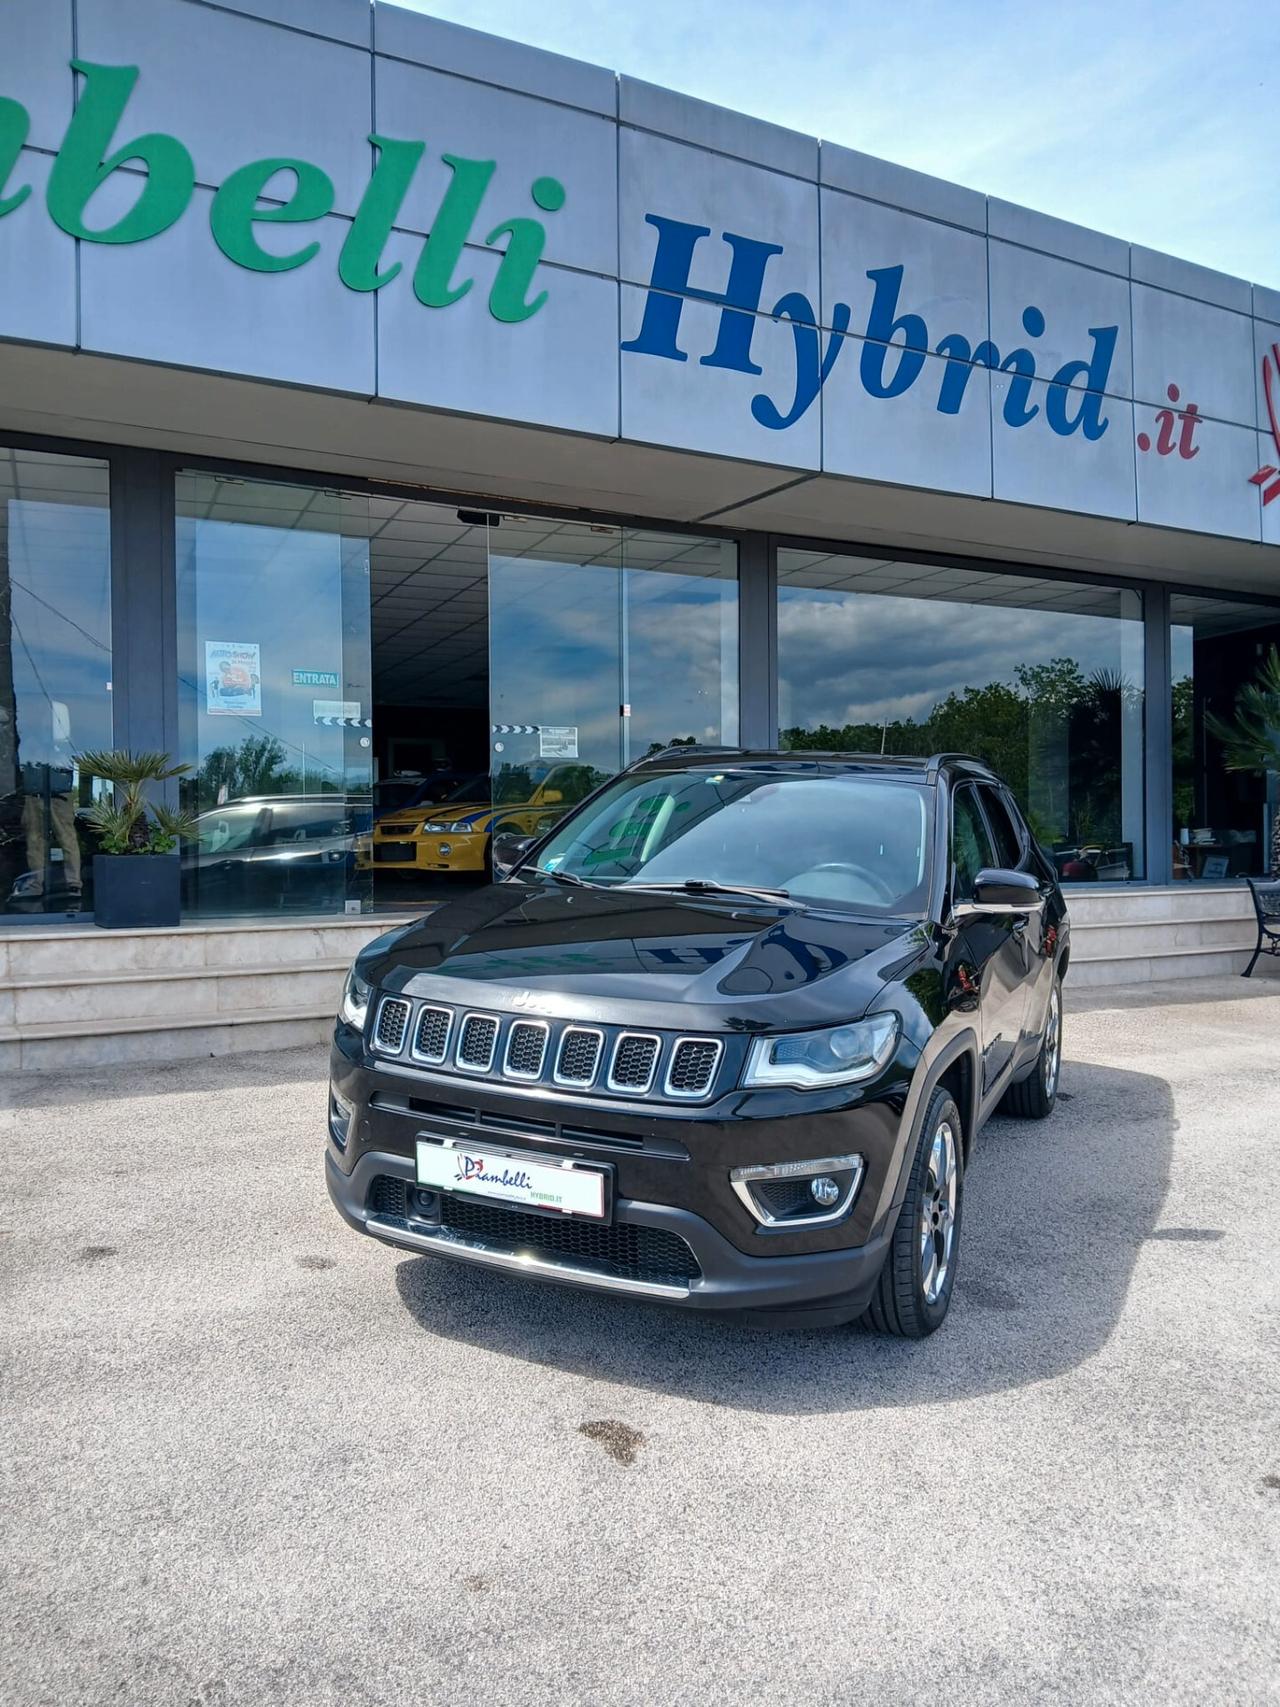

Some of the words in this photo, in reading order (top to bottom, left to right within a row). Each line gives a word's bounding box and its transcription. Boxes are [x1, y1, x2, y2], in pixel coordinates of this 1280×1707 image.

[0, 60, 564, 323] belli
[620, 214, 1117, 440] Hybrid
[293, 672, 336, 685] ENTRATA
